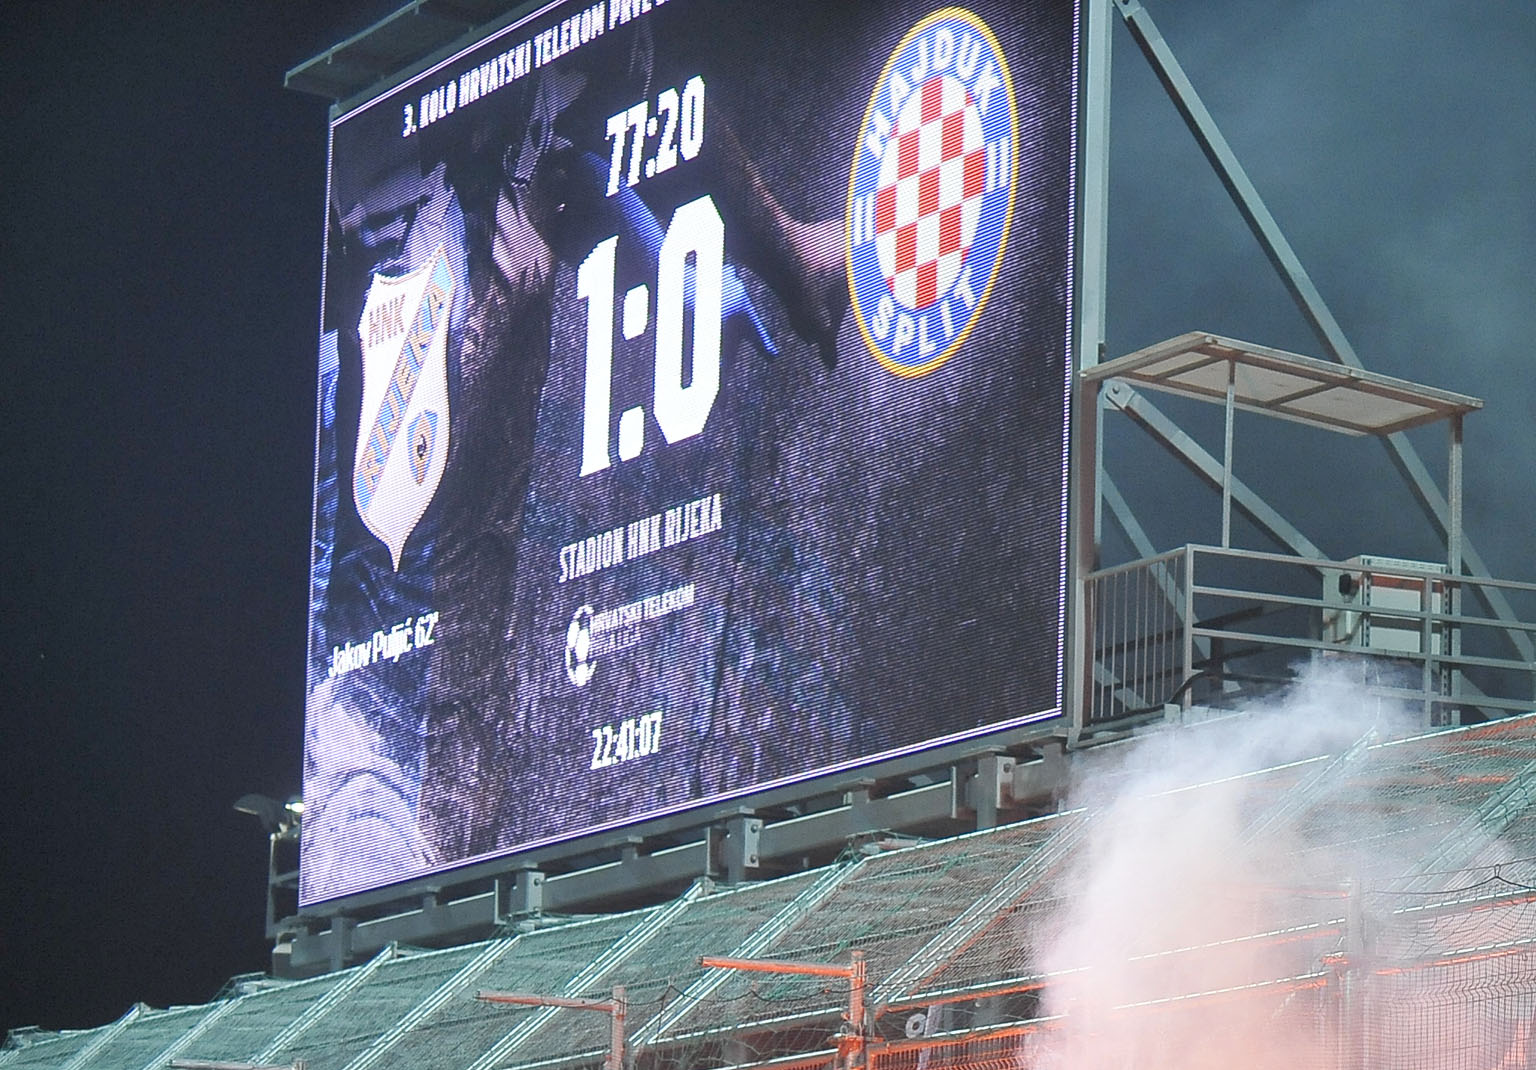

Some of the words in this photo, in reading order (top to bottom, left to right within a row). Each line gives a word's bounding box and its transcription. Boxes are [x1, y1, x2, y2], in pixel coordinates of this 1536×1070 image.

[420, 80, 458, 129] KOLO
[459, 40, 532, 108] HRVATSKI
[534, 3, 606, 68] TELEKOM
[866, 28, 1000, 158] HAJDUK
[605, 74, 705, 197] 77:20
[576, 194, 725, 477] 1:0
[871, 265, 976, 358] SPLIT
[559, 527, 625, 583] STADION
[627, 514, 662, 560] HNK
[664, 493, 722, 547] RIJEKA
[590, 711, 662, 770] 22:41:07
